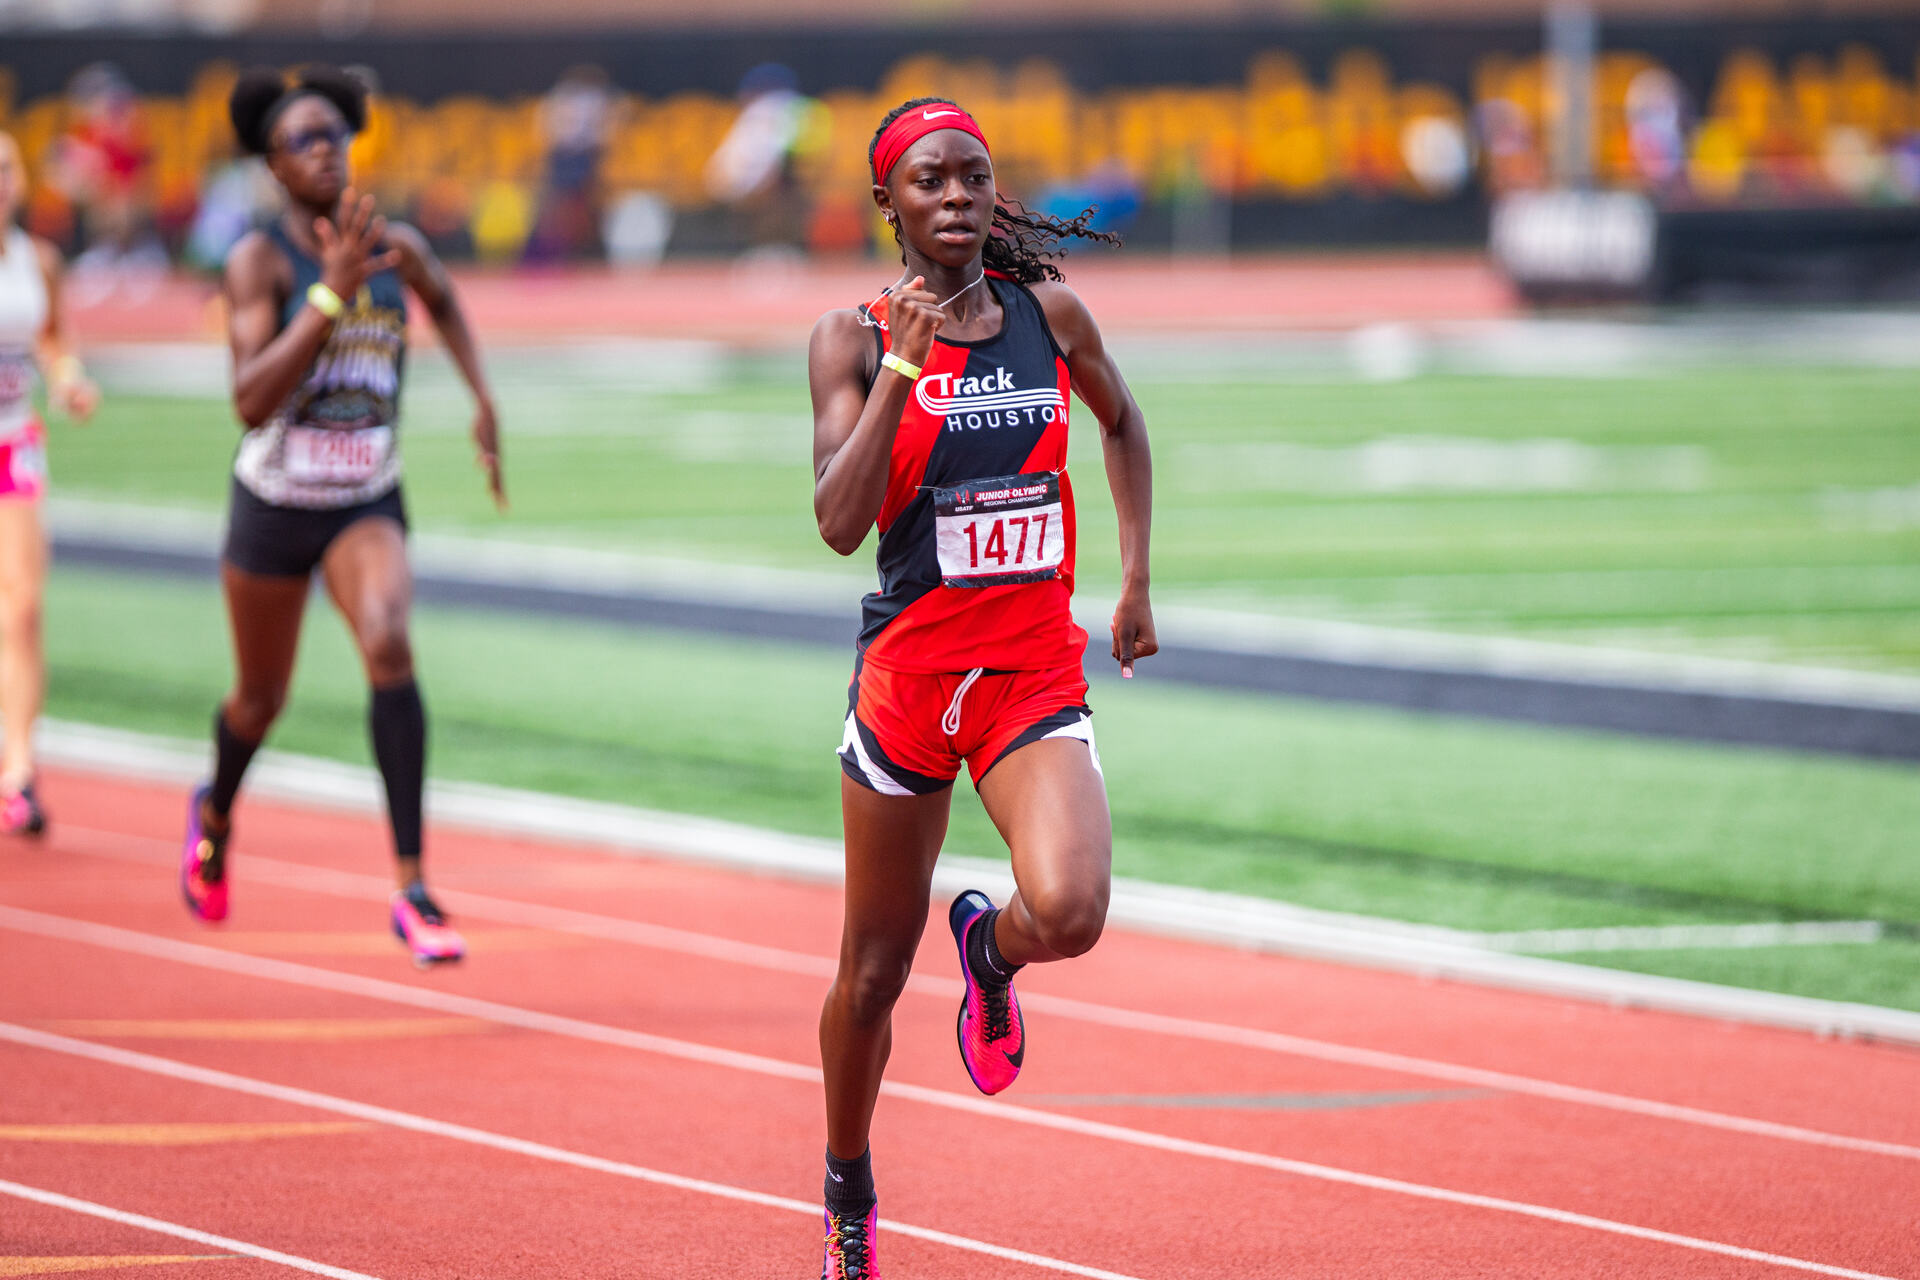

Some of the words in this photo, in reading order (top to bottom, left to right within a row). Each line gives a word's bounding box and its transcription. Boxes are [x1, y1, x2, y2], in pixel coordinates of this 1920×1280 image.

[918, 366, 1016, 397] Track
[946, 406, 1068, 432] HOUSTON
[976, 490, 1011, 501] JUNIOR
[1012, 484, 1047, 497] OLYMPIC
[963, 513, 1049, 568] 1477
